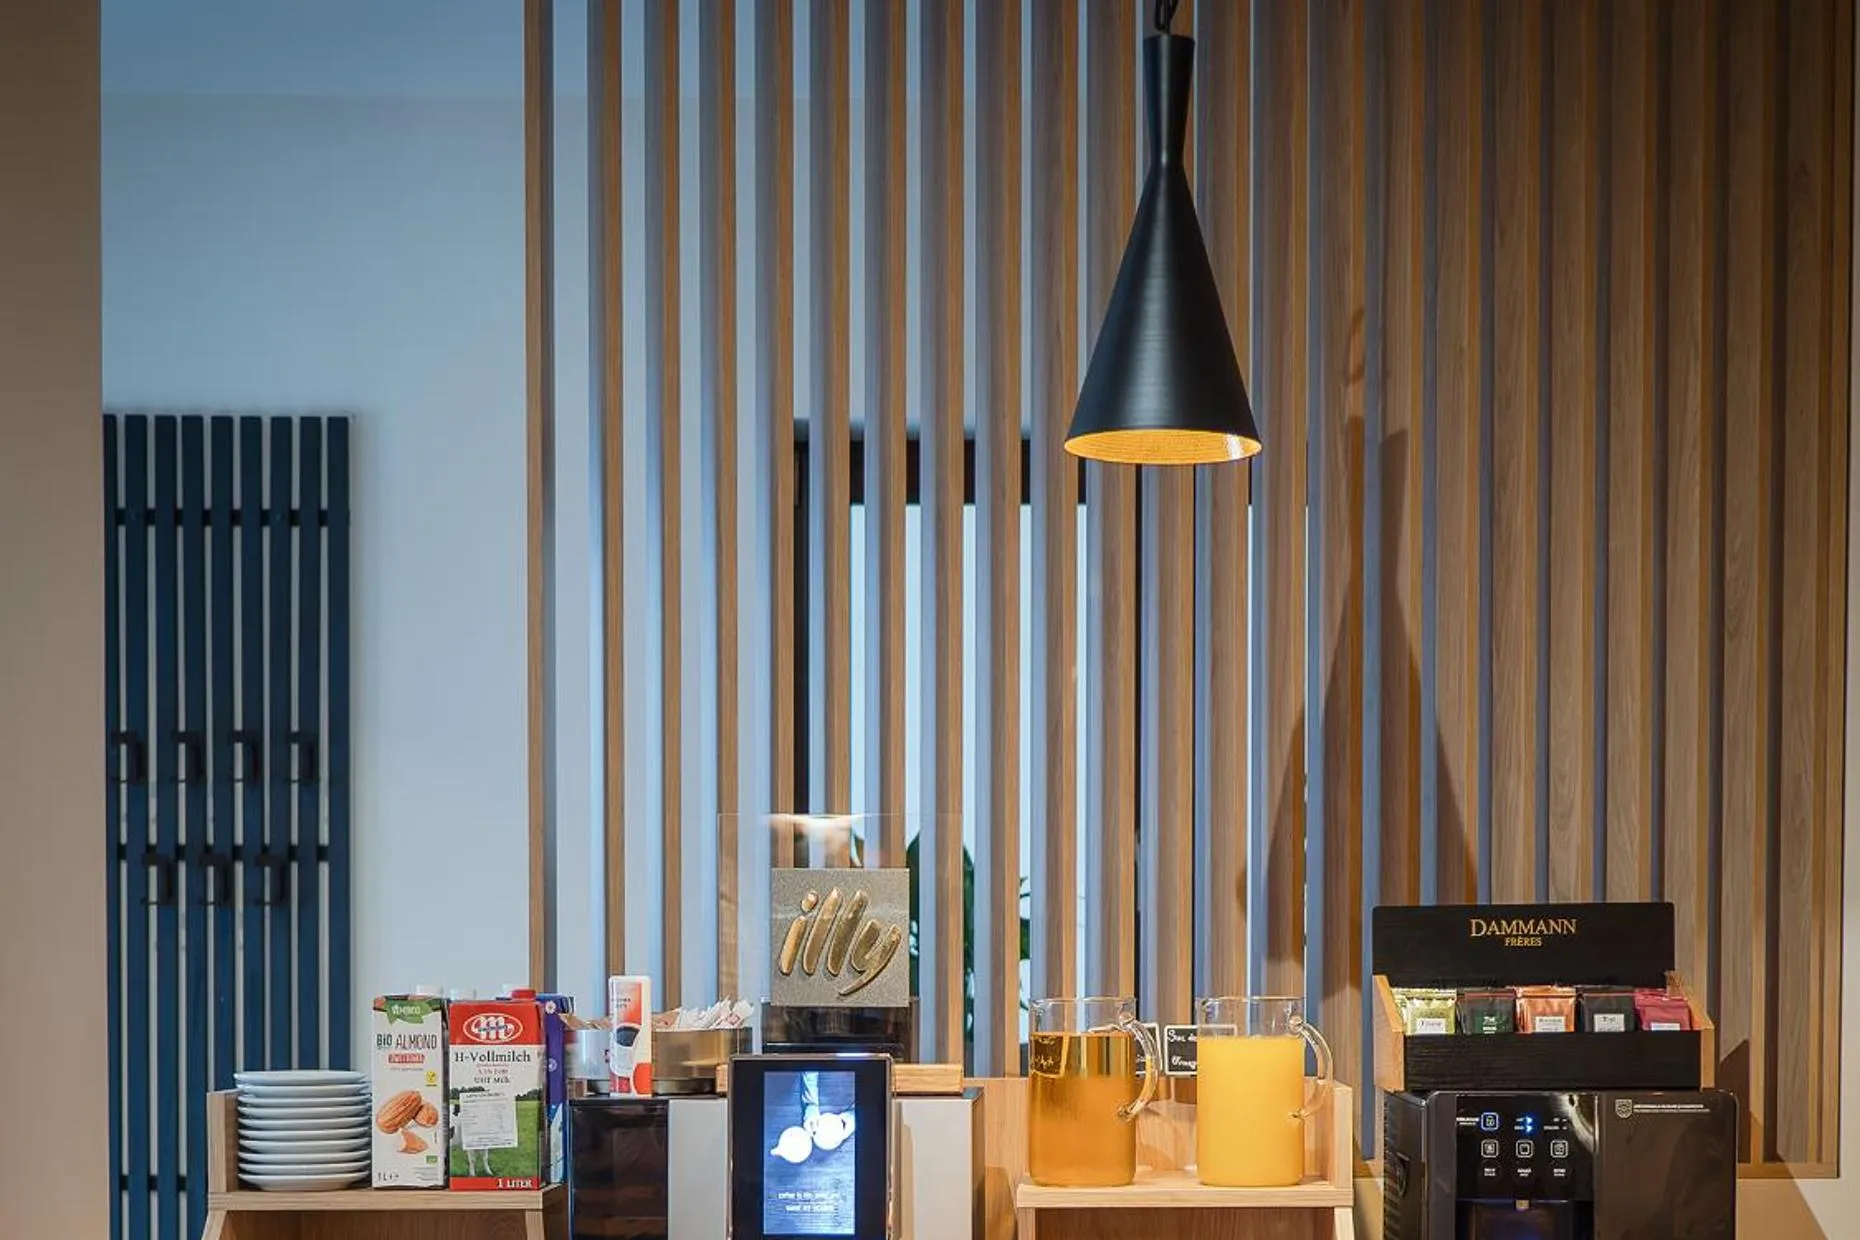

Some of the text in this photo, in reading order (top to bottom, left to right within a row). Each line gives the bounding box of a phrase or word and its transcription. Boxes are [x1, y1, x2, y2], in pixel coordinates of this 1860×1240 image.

[1470, 918, 1577, 937] DAMMANN
[780, 887, 901, 996] illy
[396, 1033, 437, 1050] ALMOND
[454, 1050, 531, 1062] H-Vollmilch
